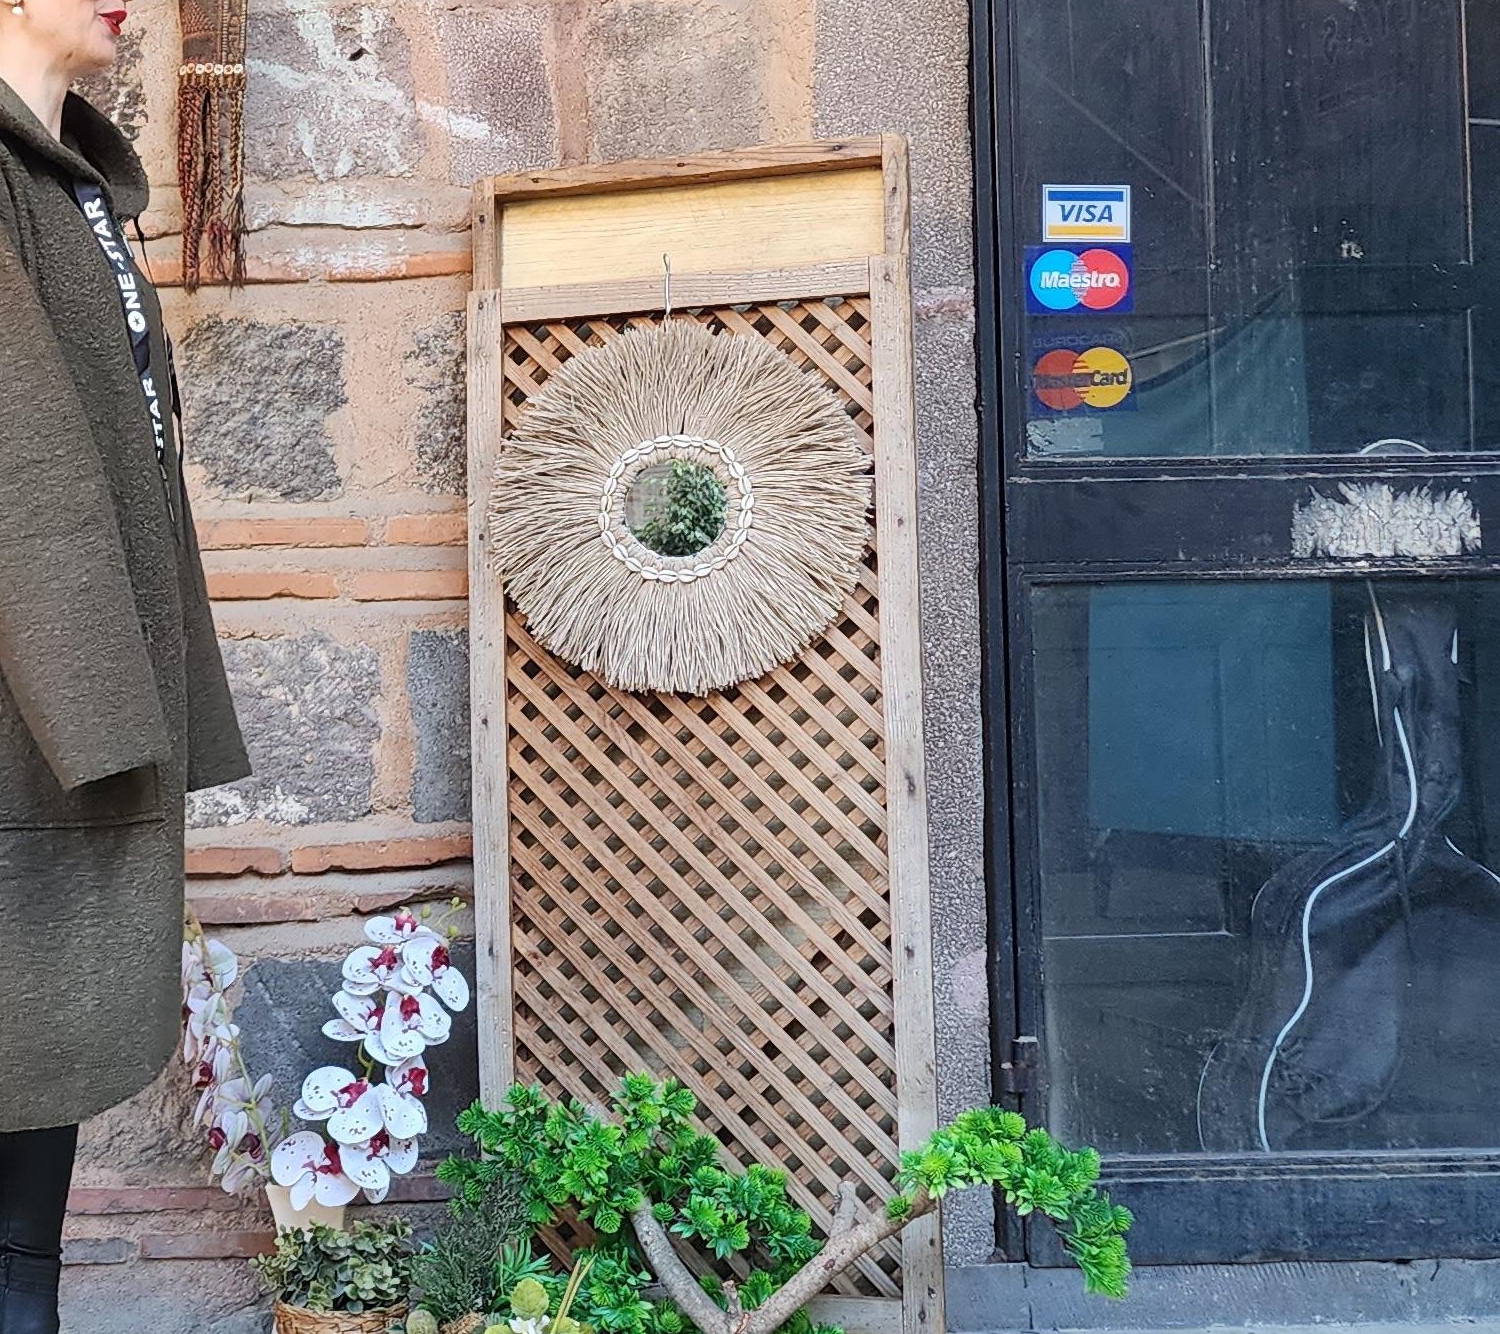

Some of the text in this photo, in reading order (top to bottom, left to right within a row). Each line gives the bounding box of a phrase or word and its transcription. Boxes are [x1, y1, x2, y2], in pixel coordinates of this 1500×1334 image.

[1058, 204, 1114, 223] VISA
[1040, 270, 1122, 289] Maestro
[116, 272, 147, 333] ONE
